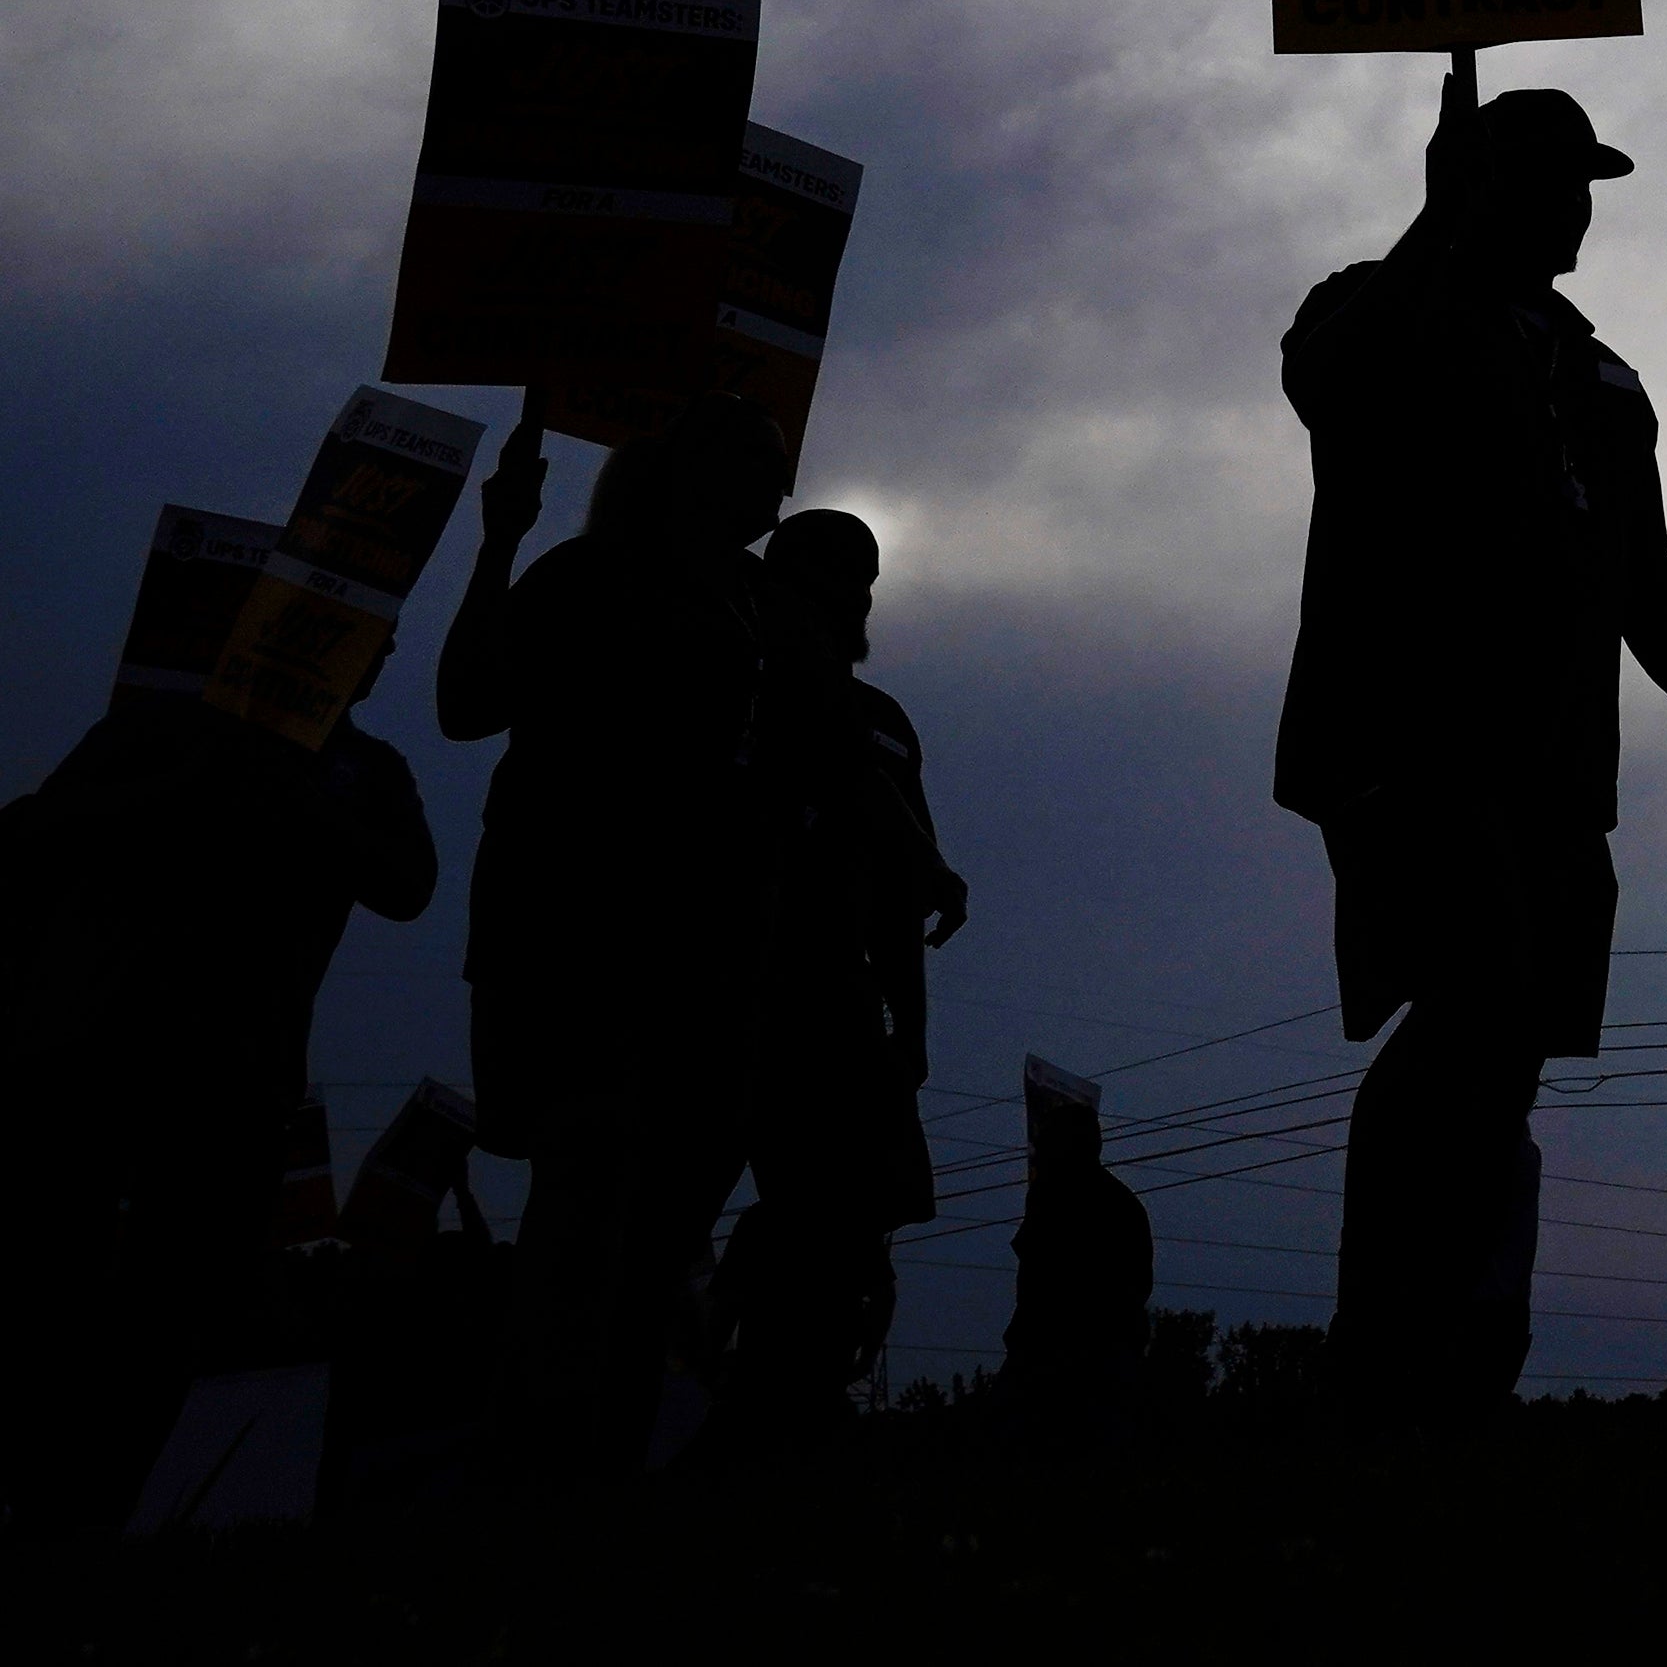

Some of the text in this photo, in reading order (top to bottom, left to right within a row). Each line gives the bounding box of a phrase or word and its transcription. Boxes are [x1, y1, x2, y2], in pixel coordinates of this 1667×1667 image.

[739, 148, 847, 203] EAMSTERS:
[541, 188, 617, 213] FOR A
[363, 419, 391, 441] UPS
[205, 538, 246, 560] UPS
[305, 570, 350, 598] FOR A
